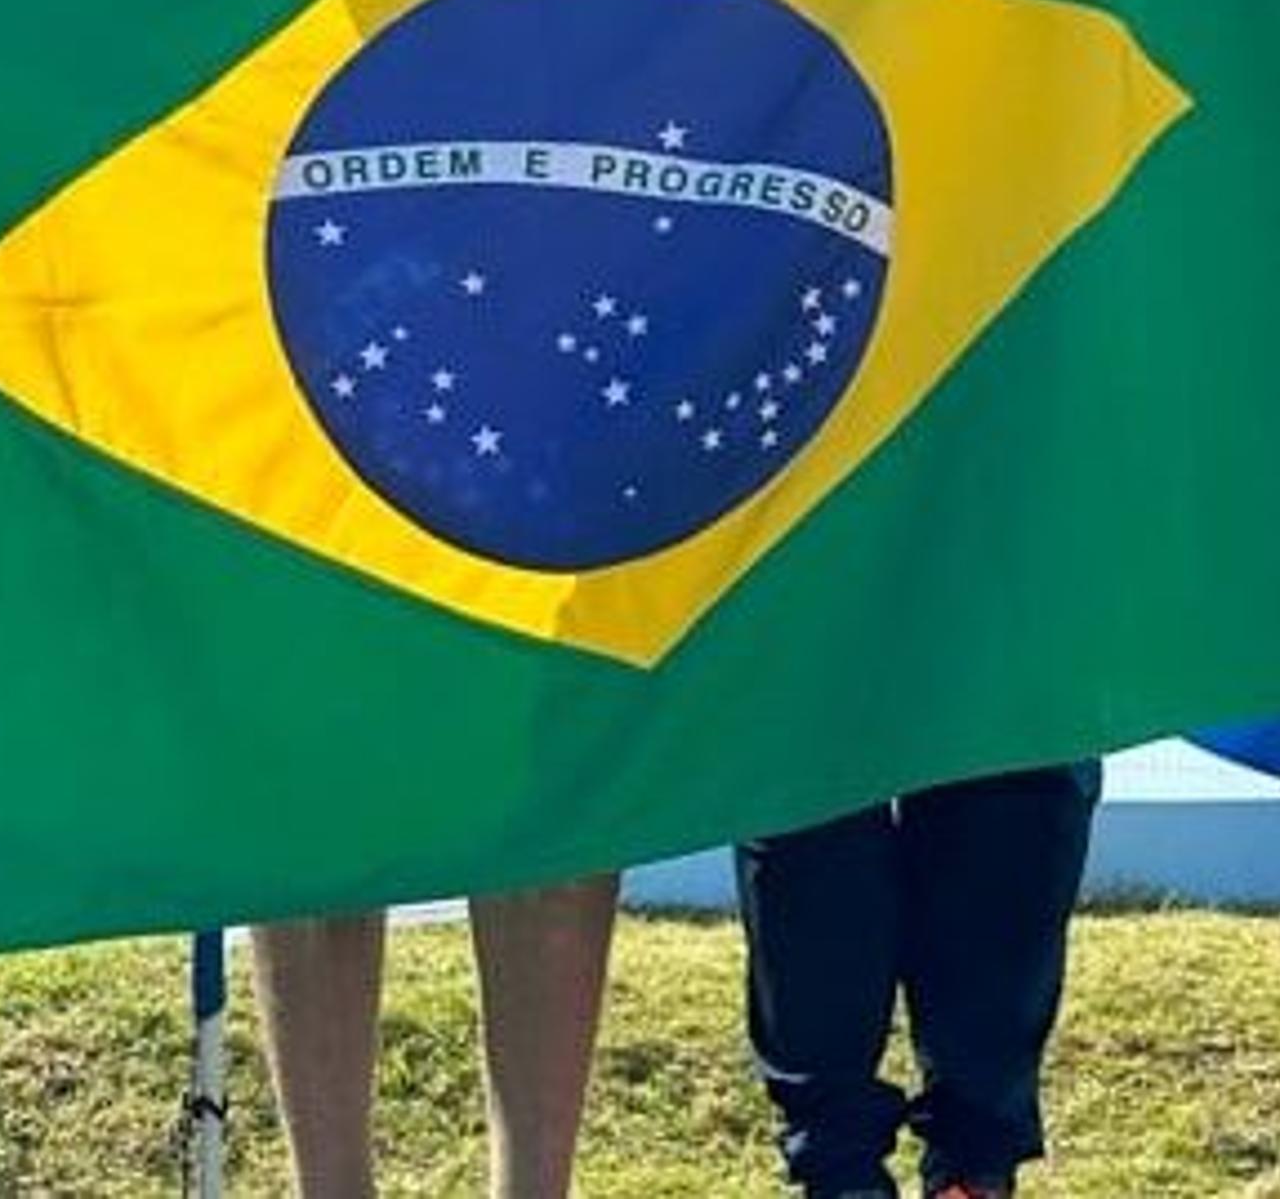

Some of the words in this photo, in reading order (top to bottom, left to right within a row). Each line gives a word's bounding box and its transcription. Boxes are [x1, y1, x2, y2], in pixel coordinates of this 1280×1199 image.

[302, 148, 483, 190] ORDEM
[524, 149, 552, 179] E
[590, 154, 872, 235] PROGRESSO
